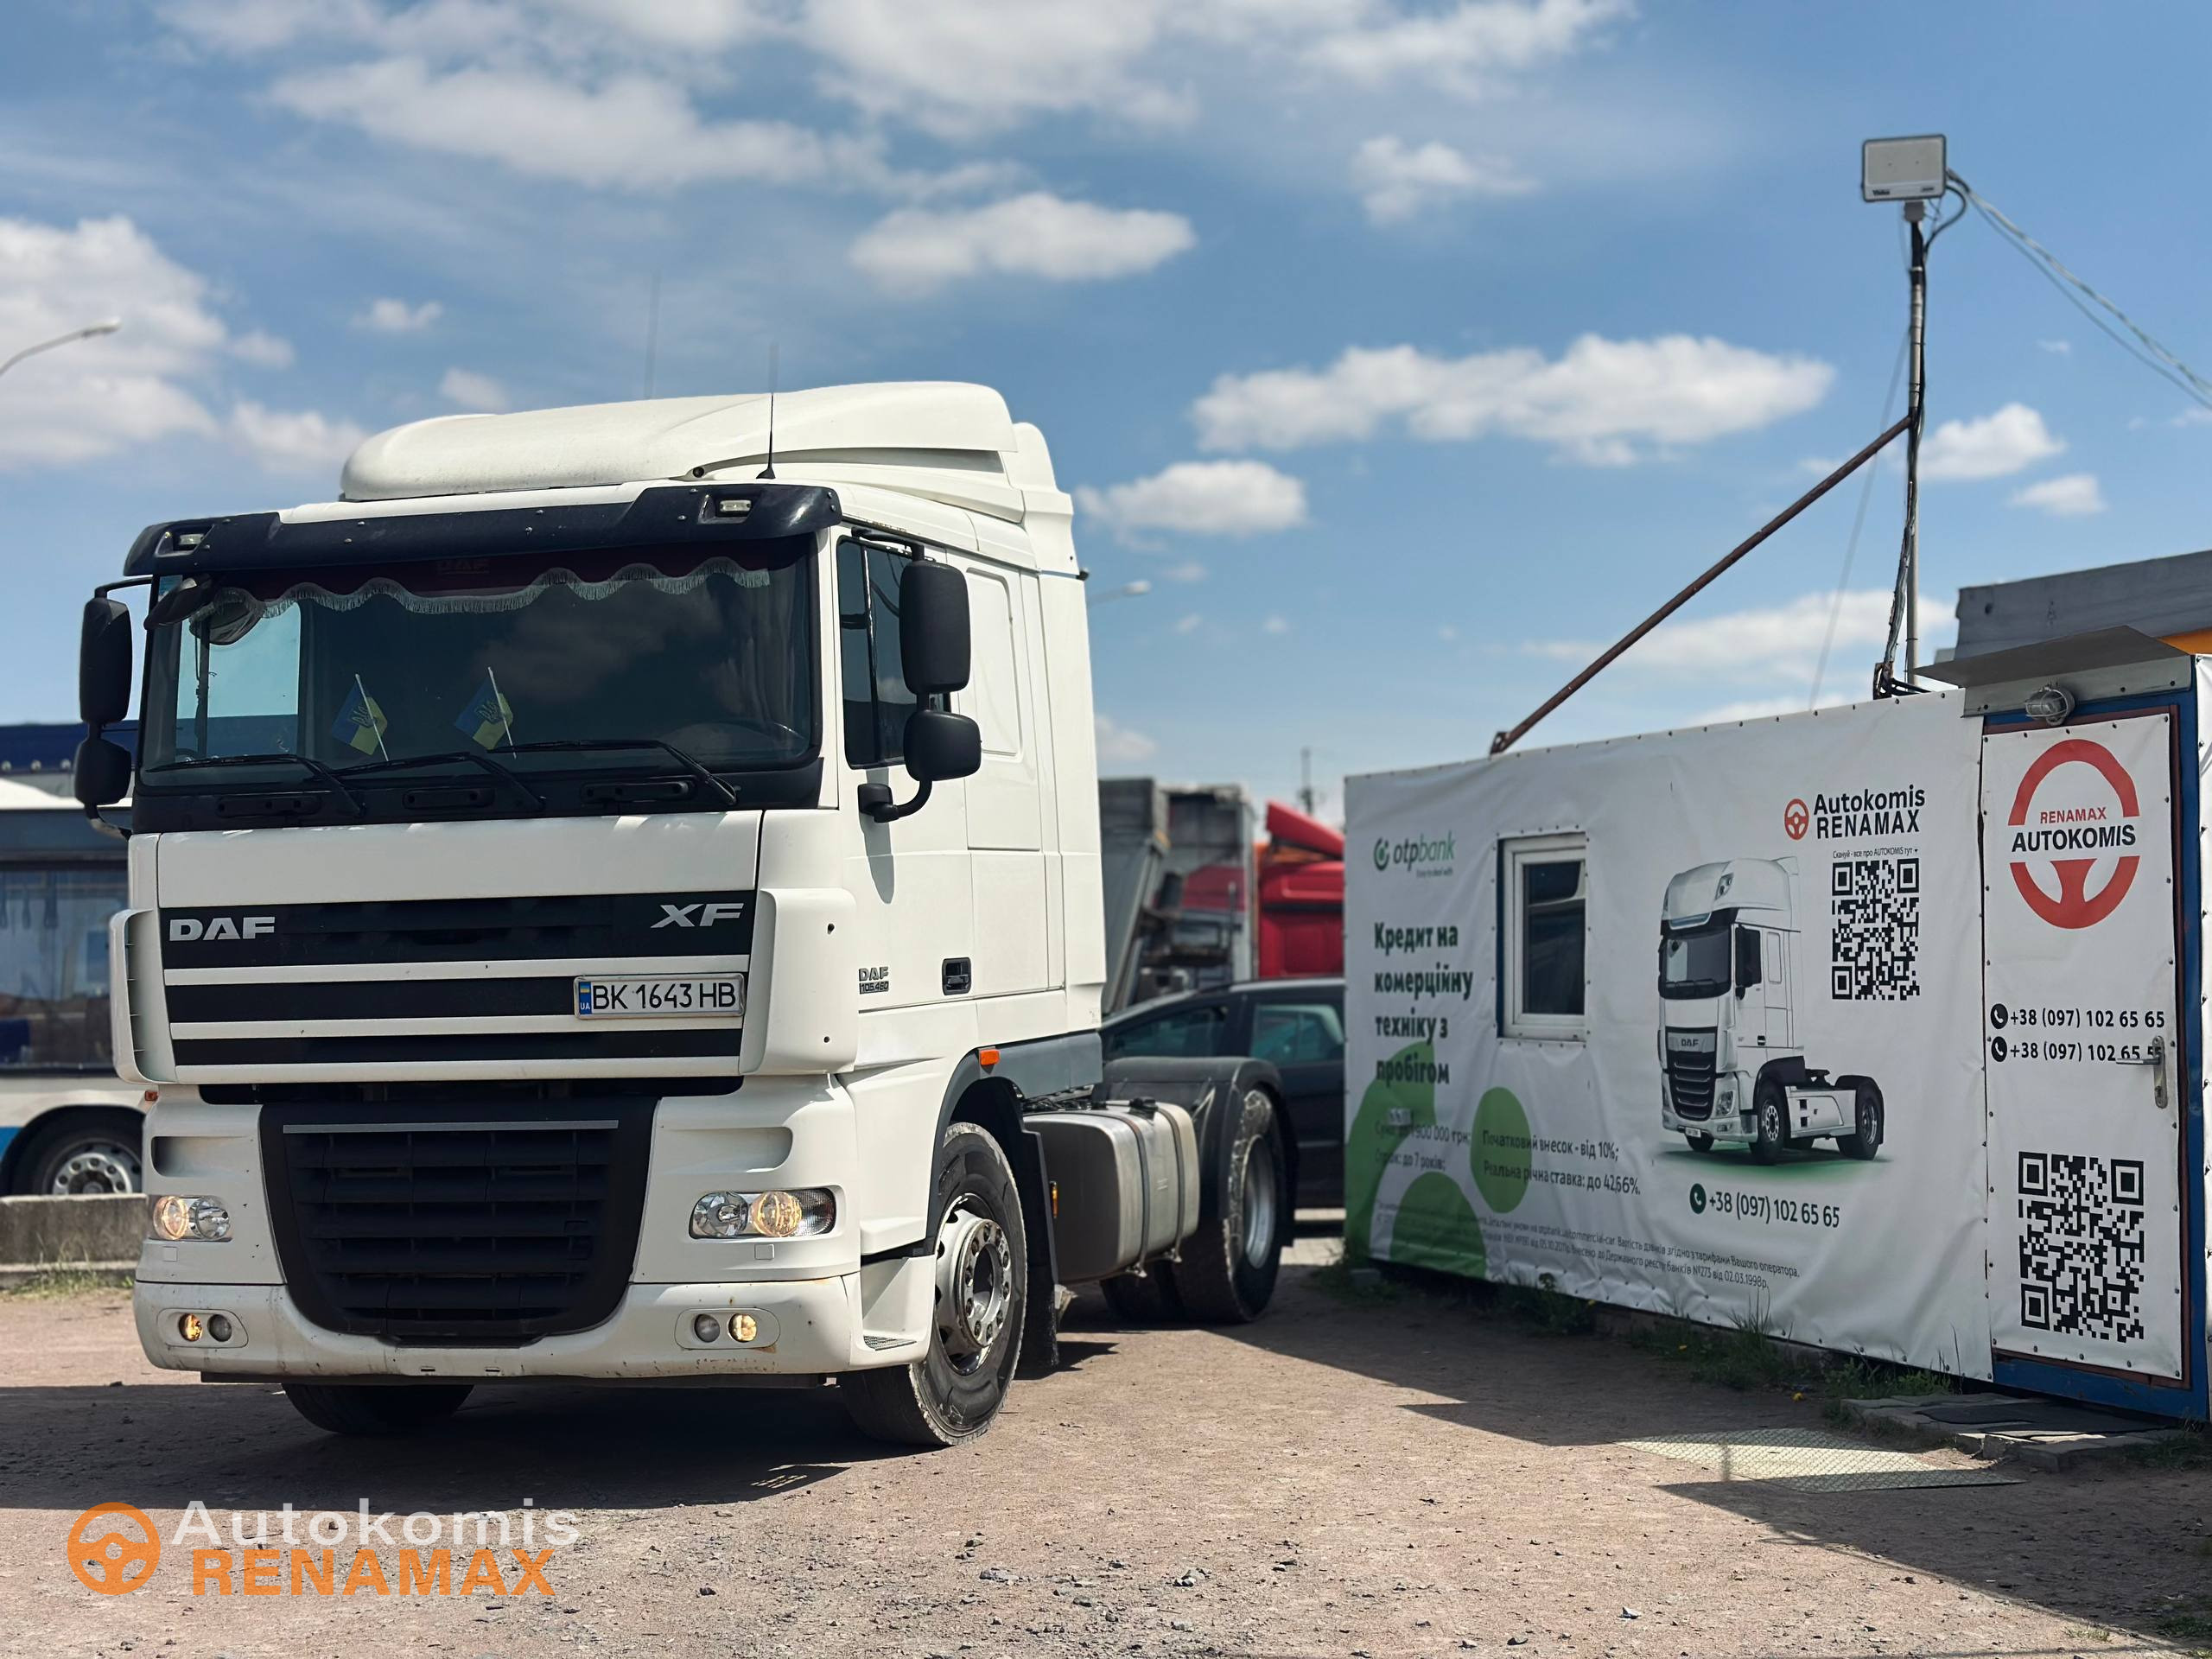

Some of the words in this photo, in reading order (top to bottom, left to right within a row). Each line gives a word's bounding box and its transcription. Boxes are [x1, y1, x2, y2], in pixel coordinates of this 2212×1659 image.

[1813, 784, 1925, 815] Autokomis
[1817, 809, 1920, 839] RENAMAX
[2040, 806, 2107, 823] RENAMAX
[1393, 830, 1456, 872] otpbank
[1873, 847, 1904, 856] AUTOKOMIS
[2012, 824, 2136, 853] AUTOKOMIS
[169, 917, 275, 941] DAF
[650, 903, 744, 929] XF
[1374, 922, 1433, 957] Кредит
[1437, 925, 1459, 948] на
[858, 967, 889, 982] DAF
[1374, 962, 1473, 1001] комерційну
[593, 984, 629, 1010] BK
[636, 983, 693, 1009] 1643
[699, 982, 736, 1008] HB
[1376, 1007, 1436, 1046] техніку
[1440, 1017, 1448, 1039] з
[2010, 1009, 2037, 1026] +38
[2042, 1007, 2081, 1027] (097)
[2086, 1010, 2114, 1027] 102
[2120, 1011, 2139, 1027] 65
[2145, 1011, 2164, 1028] 65
[2010, 1042, 2038, 1058] +38
[2044, 1041, 2082, 1062] (097)
[2088, 1045, 2116, 1061] 102
[1376, 1052, 1450, 1088] пробігом
[1540, 1138, 1573, 1155] внесок
[1580, 1140, 1596, 1160] від
[1586, 1177, 1602, 1192] до
[1710, 1191, 1733, 1213] +38
[1737, 1192, 1770, 1224] (097)
[1774, 1198, 1798, 1223] 102
[1802, 1203, 1819, 1225] 65
[1823, 1205, 1840, 1228] 65
